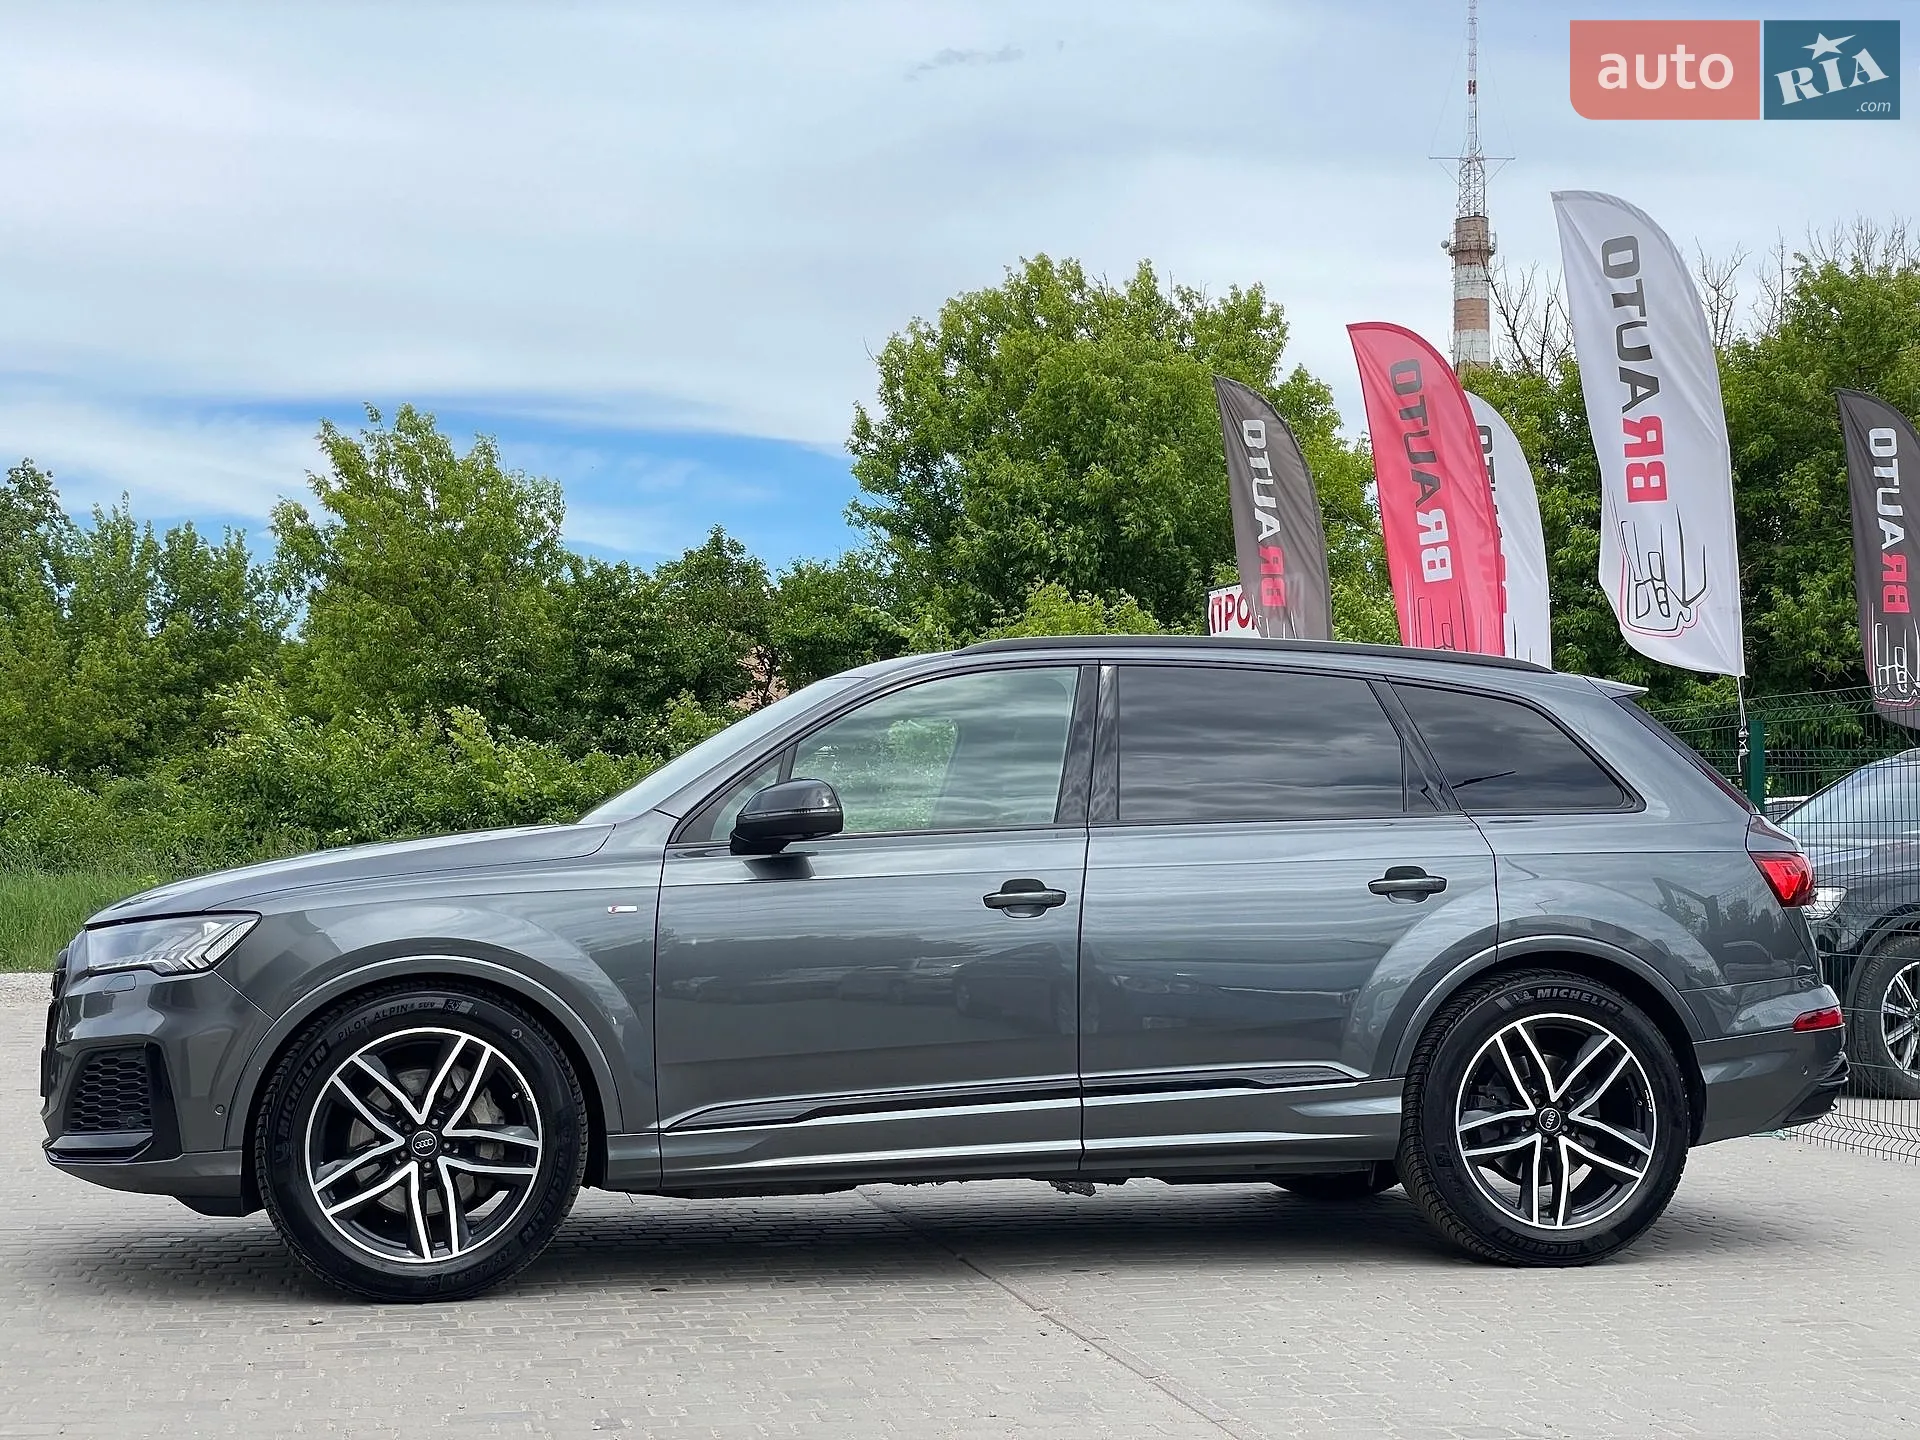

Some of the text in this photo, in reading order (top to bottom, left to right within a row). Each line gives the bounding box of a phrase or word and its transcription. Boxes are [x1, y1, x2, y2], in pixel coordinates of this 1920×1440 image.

[1211, 593, 1256, 634] ПРО
[1537, 988, 1620, 1013] MICHELIN
[338, 1017, 368, 1041] PILOT
[278, 1042, 330, 1138] MICHELIN
